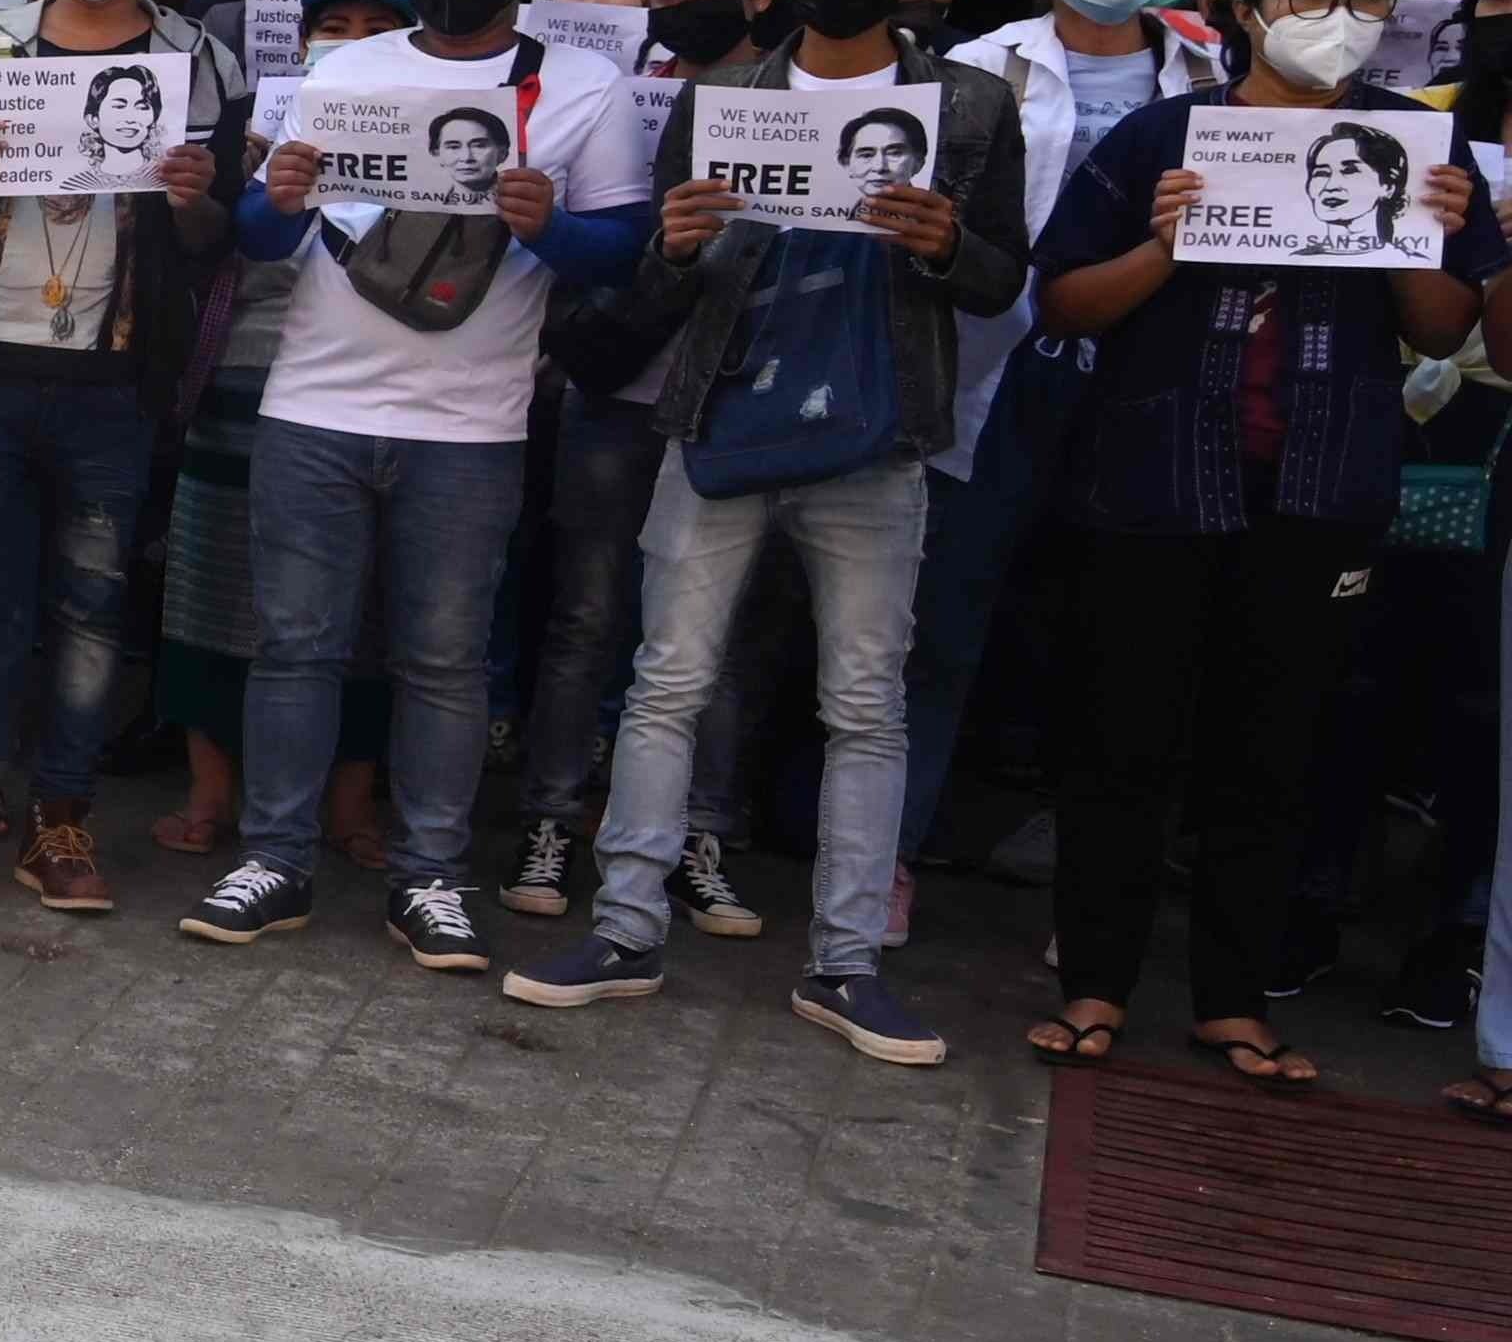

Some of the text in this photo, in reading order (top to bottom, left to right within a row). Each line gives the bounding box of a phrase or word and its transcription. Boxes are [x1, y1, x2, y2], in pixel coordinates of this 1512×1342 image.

[255, 10, 300, 24] Justice
[547, 17, 618, 36] WE WANT
[255, 30, 292, 44] #Free
[570, 36, 624, 52] LEADER
[255, 51, 288, 64] From
[7, 72, 30, 86] We
[35, 70, 76, 86] Want
[323, 102, 400, 118] WE WANT
[720, 108, 809, 125] WE WANT
[313, 118, 411, 135] OUR LEADER
[708, 123, 820, 143] OUR LEADER
[1196, 130, 1275, 143] WE WANT
[35, 142, 63, 158] Our
[1192, 151, 1296, 164] OUR LEADER
[319, 152, 407, 181] FREE
[708, 161, 813, 196] FREE
[318, 183, 354, 195] DAW
[360, 187, 405, 201] AUNG
[411, 190, 446, 203] SAN
[751, 202, 850, 219] AUNG SAN
[1184, 205, 1273, 228] FREE
[1182, 231, 1430, 250] DAW AUNG SAN SU KYI
